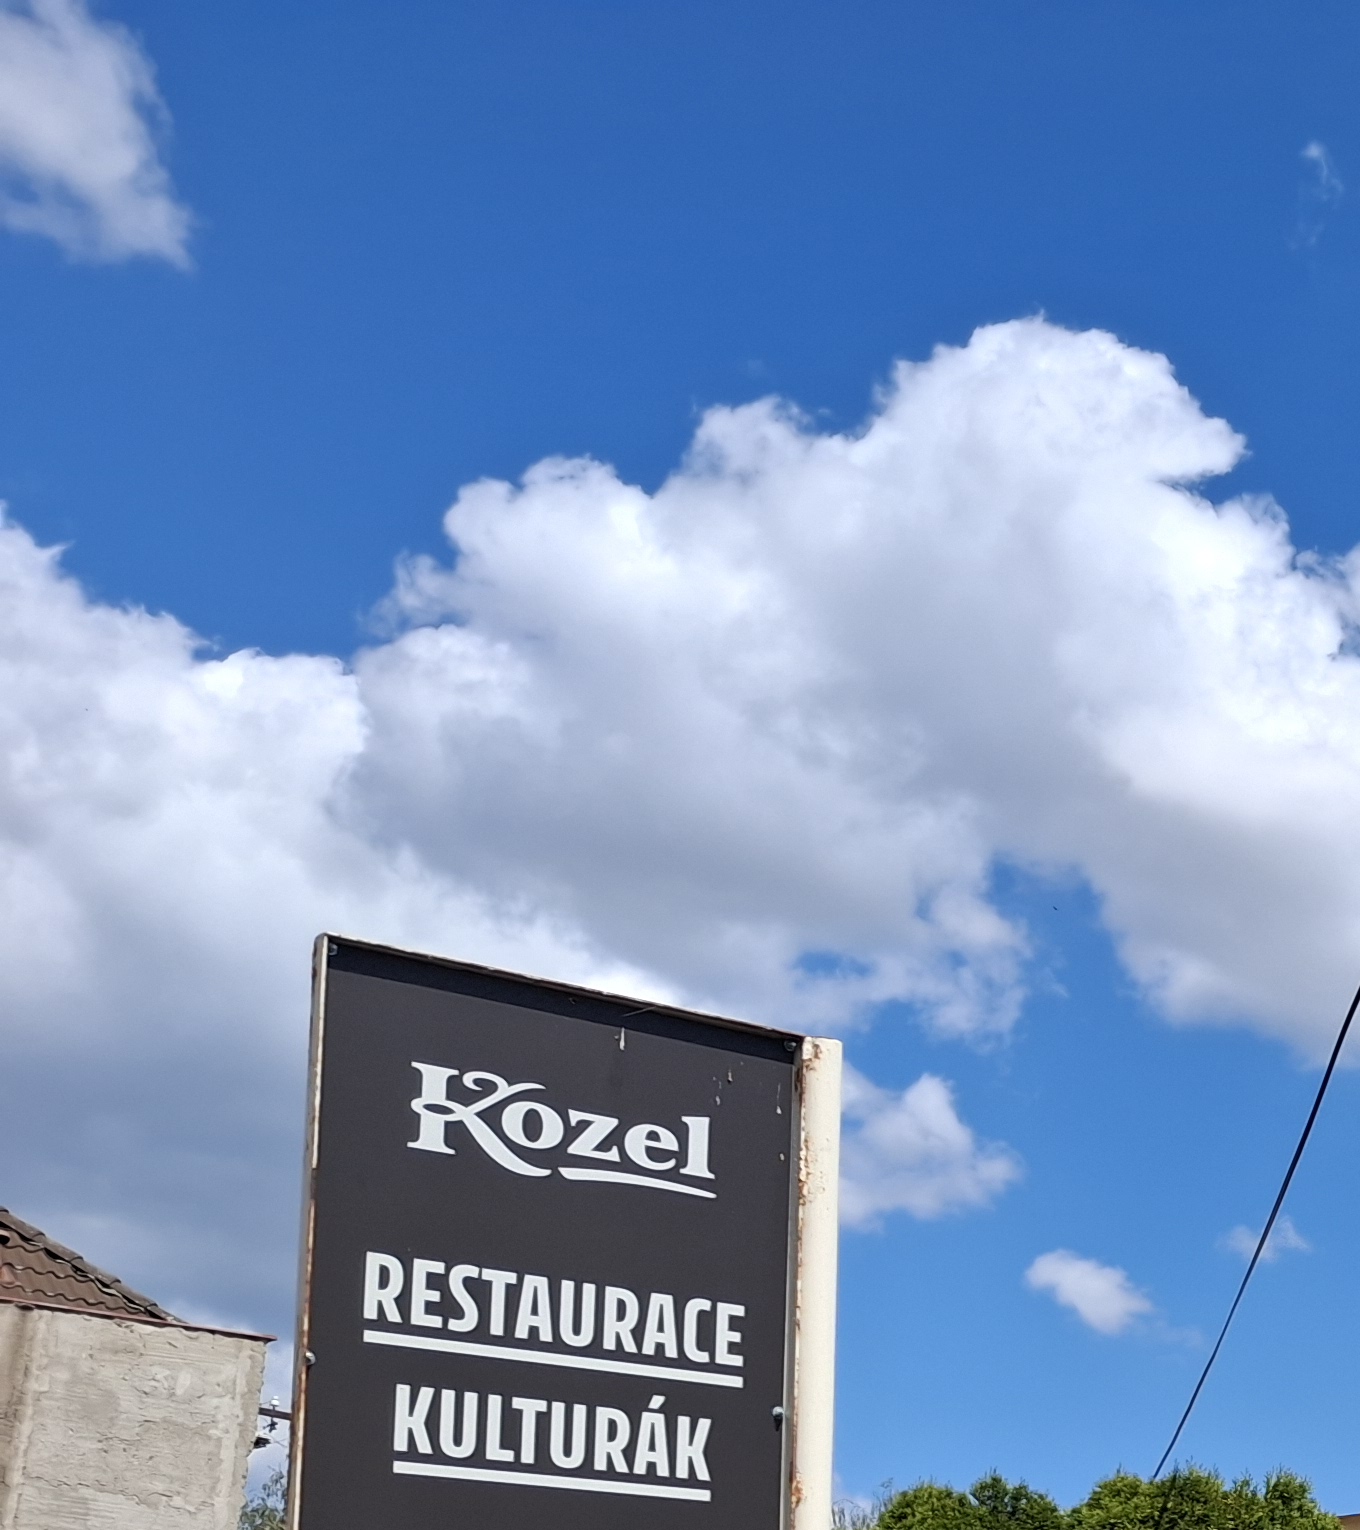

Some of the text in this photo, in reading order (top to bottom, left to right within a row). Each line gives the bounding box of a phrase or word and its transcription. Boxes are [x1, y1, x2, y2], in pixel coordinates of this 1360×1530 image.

[406, 1061, 717, 1180] Kozel
[362, 1250, 746, 1367] RESTAURACE
[392, 1383, 713, 1483] KULTURÁK
